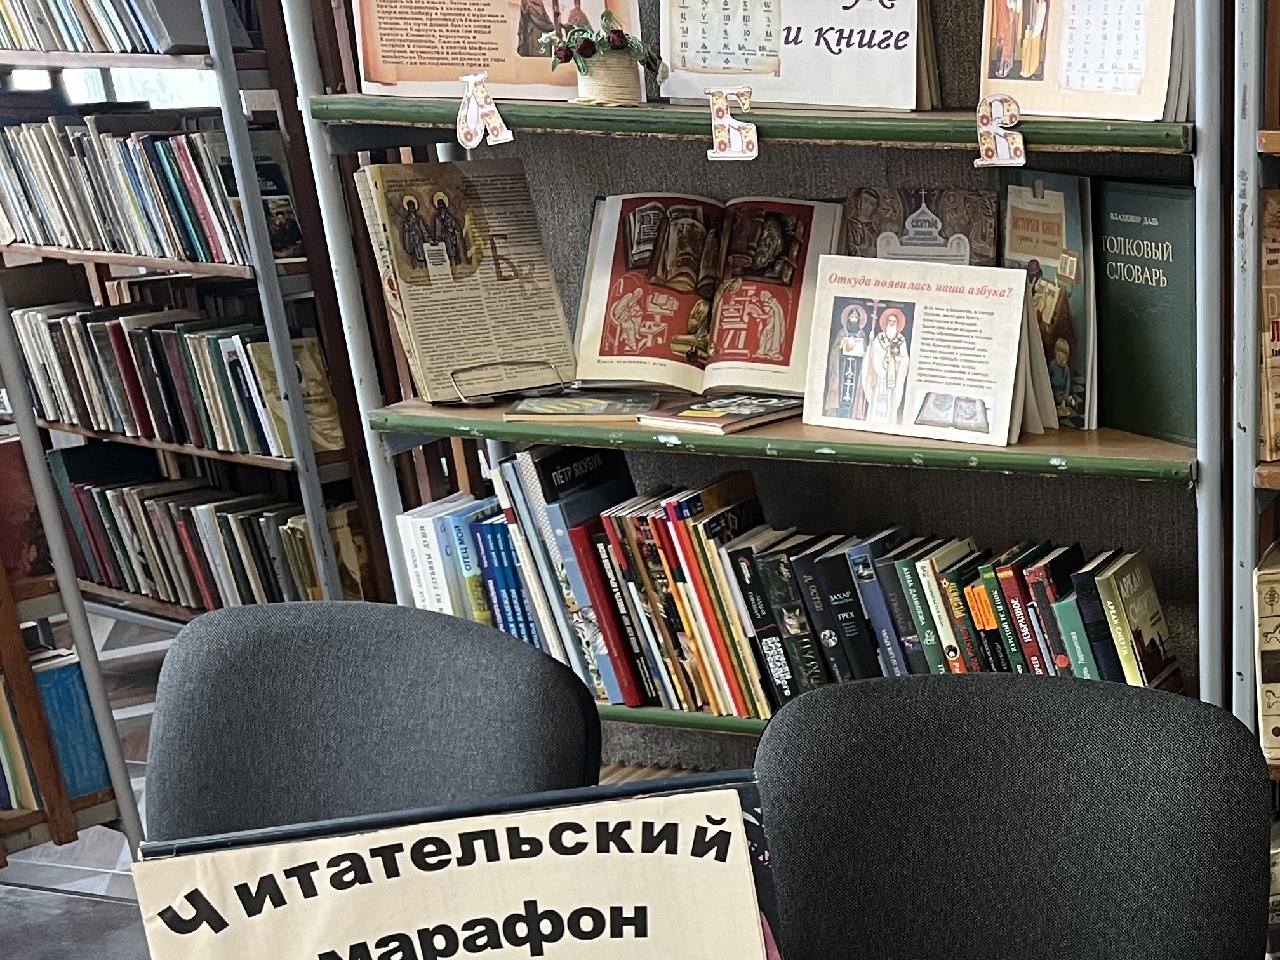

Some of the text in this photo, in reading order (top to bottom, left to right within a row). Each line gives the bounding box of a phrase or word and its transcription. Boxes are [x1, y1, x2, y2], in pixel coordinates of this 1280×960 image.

[783, 25, 910, 56] и книге
[1110, 212, 1159, 226] ВЛАДИМИР ДАЛЬ
[1101, 235, 1173, 262] ТОЛКОВЫЙ
[829, 272, 1013, 298] Откуда появилась наша азбука?
[1106, 262, 1168, 287] СЛОВАРЬ
[453, 525, 472, 572] ОТЕЦ МОЙ
[829, 591, 852, 601] ЗАХАР
[838, 610, 854, 621] ГРЕХ
[1106, 599, 1130, 657] АРКАН СМЕРТИ
[157, 814, 732, 939] Читательский
